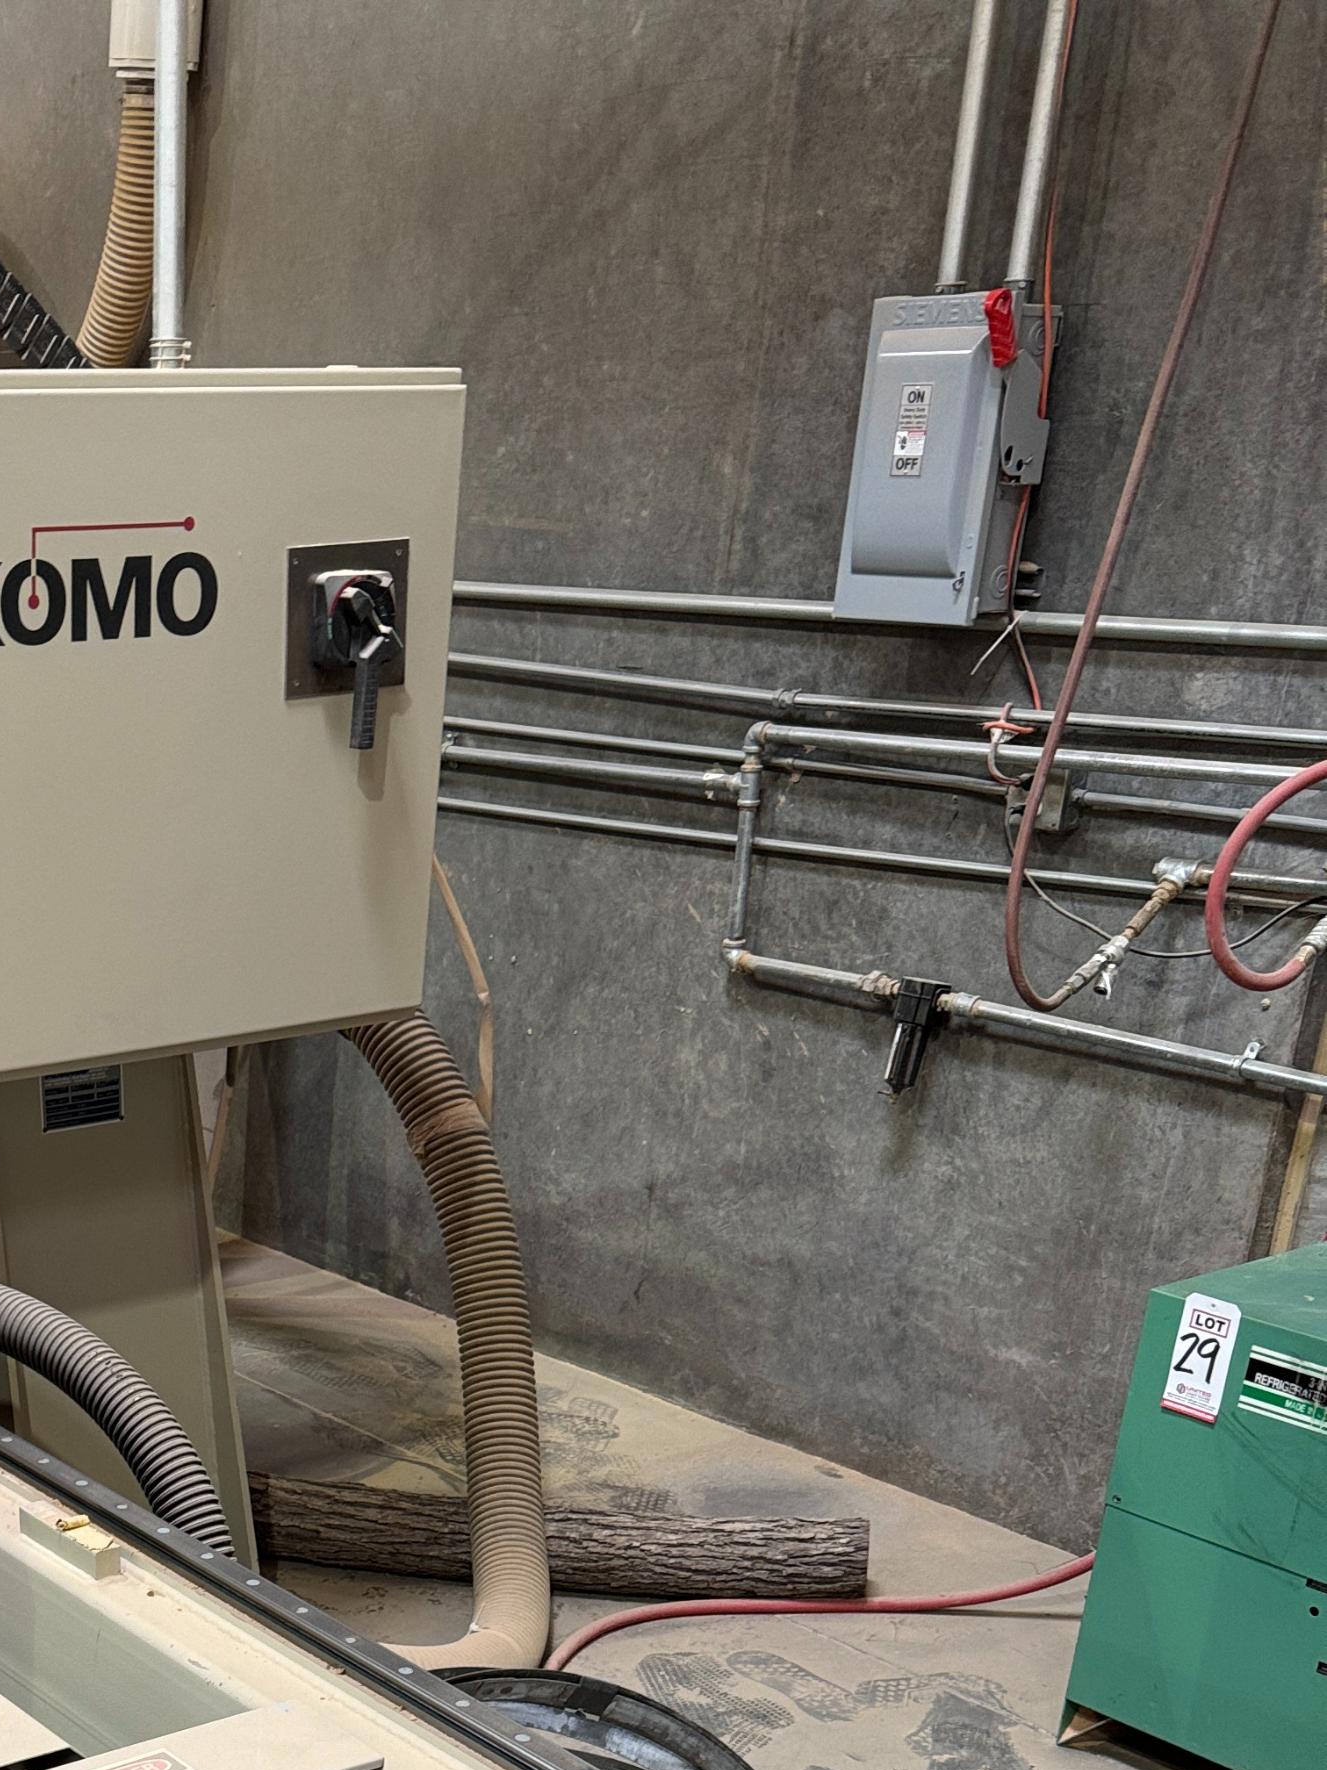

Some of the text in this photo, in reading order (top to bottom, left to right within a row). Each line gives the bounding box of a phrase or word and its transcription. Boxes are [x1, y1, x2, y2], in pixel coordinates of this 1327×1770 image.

[907, 390, 926, 404] ON
[895, 457, 919, 471] OFF
[1194, 1313, 1226, 1333] LOT
[1173, 1332, 1221, 1385] 29
[1253, 1371, 1327, 1403] REFRIGERATED
[1284, 1399, 1307, 1413] MADE
